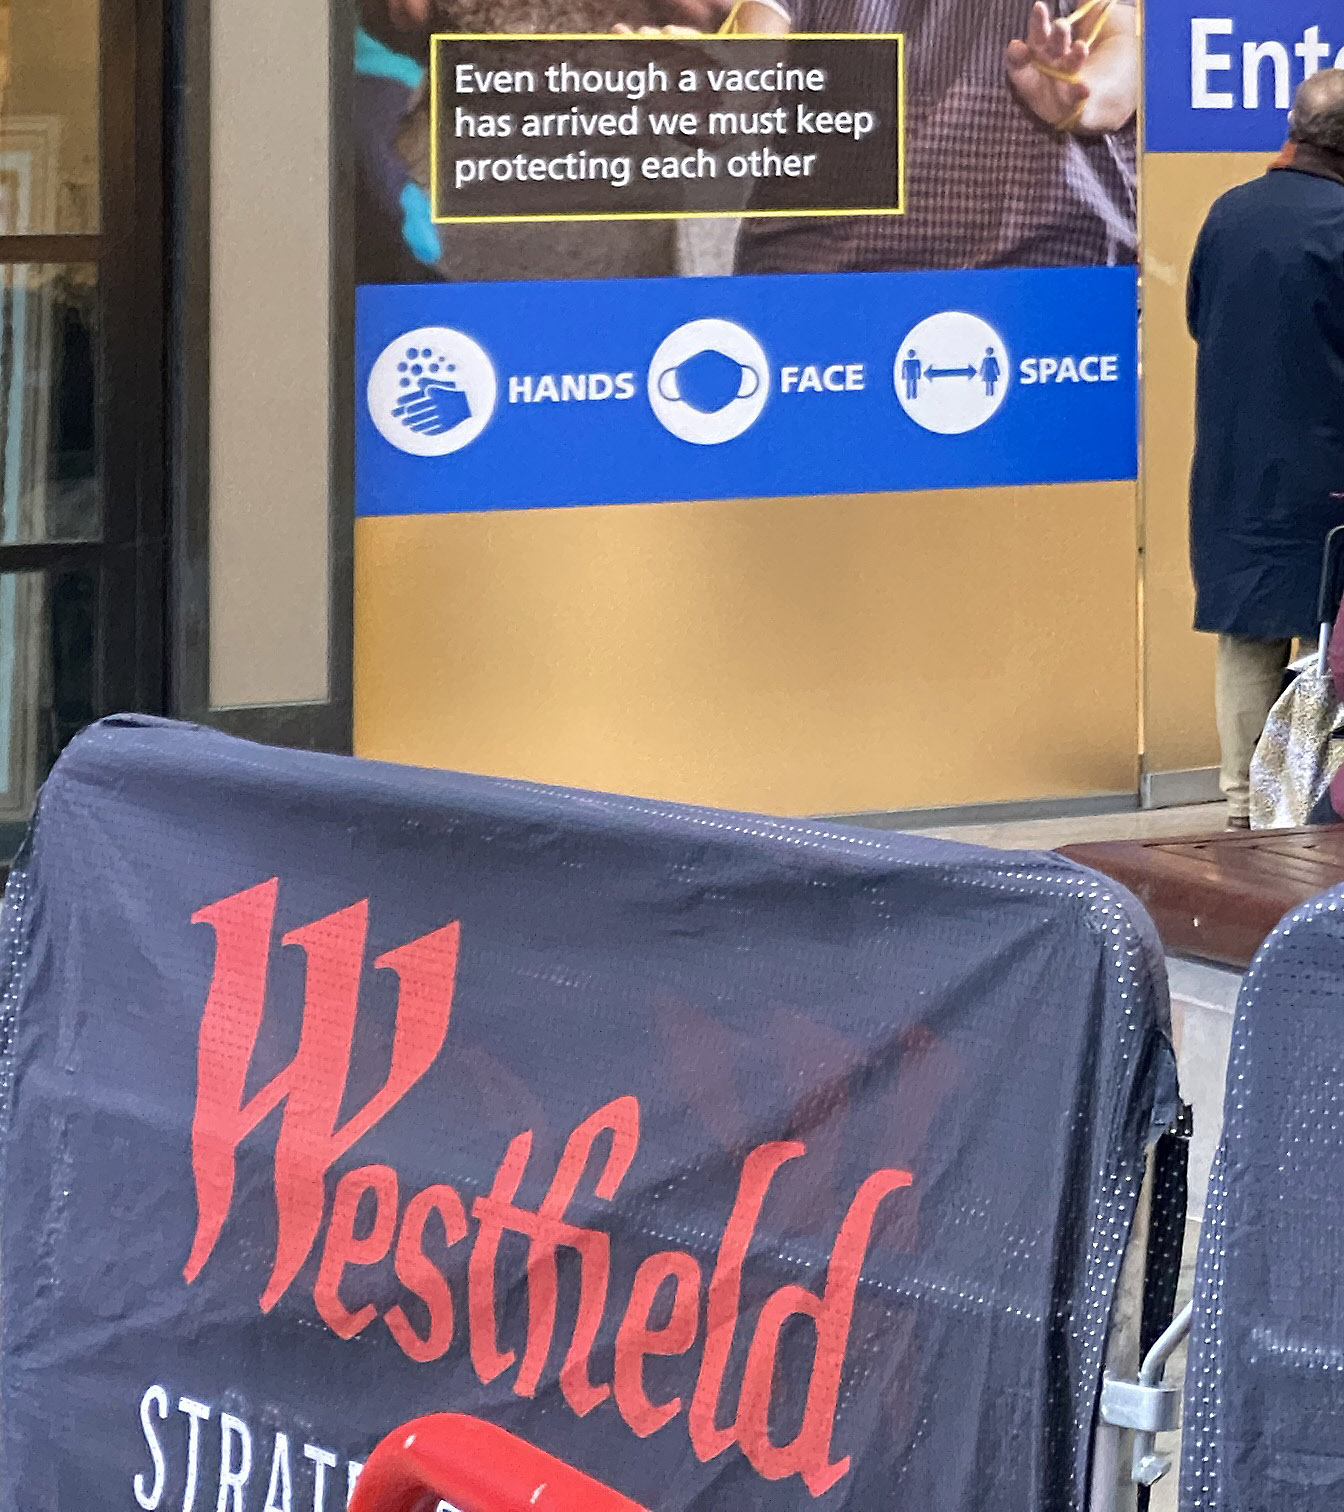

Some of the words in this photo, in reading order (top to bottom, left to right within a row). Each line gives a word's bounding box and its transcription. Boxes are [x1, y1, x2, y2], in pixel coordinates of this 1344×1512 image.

[454, 65, 535, 94] Even
[545, 63, 668, 100] though
[678, 70, 697, 91] a
[707, 63, 824, 91] vaccine
[454, 107, 511, 137] has
[522, 106, 638, 136] arrived
[649, 112, 698, 135] we
[708, 108, 787, 135] must
[797, 104, 874, 140] keep
[455, 152, 630, 188] protecting
[641, 149, 717, 180] each
[727, 148, 816, 178] other
[508, 373, 635, 405] HANDS
[780, 365, 866, 395] FACE
[1019, 355, 1119, 387] SPACE
[183, 878, 913, 1496] Westfield
[134, 1384, 367, 1512] STRAT
